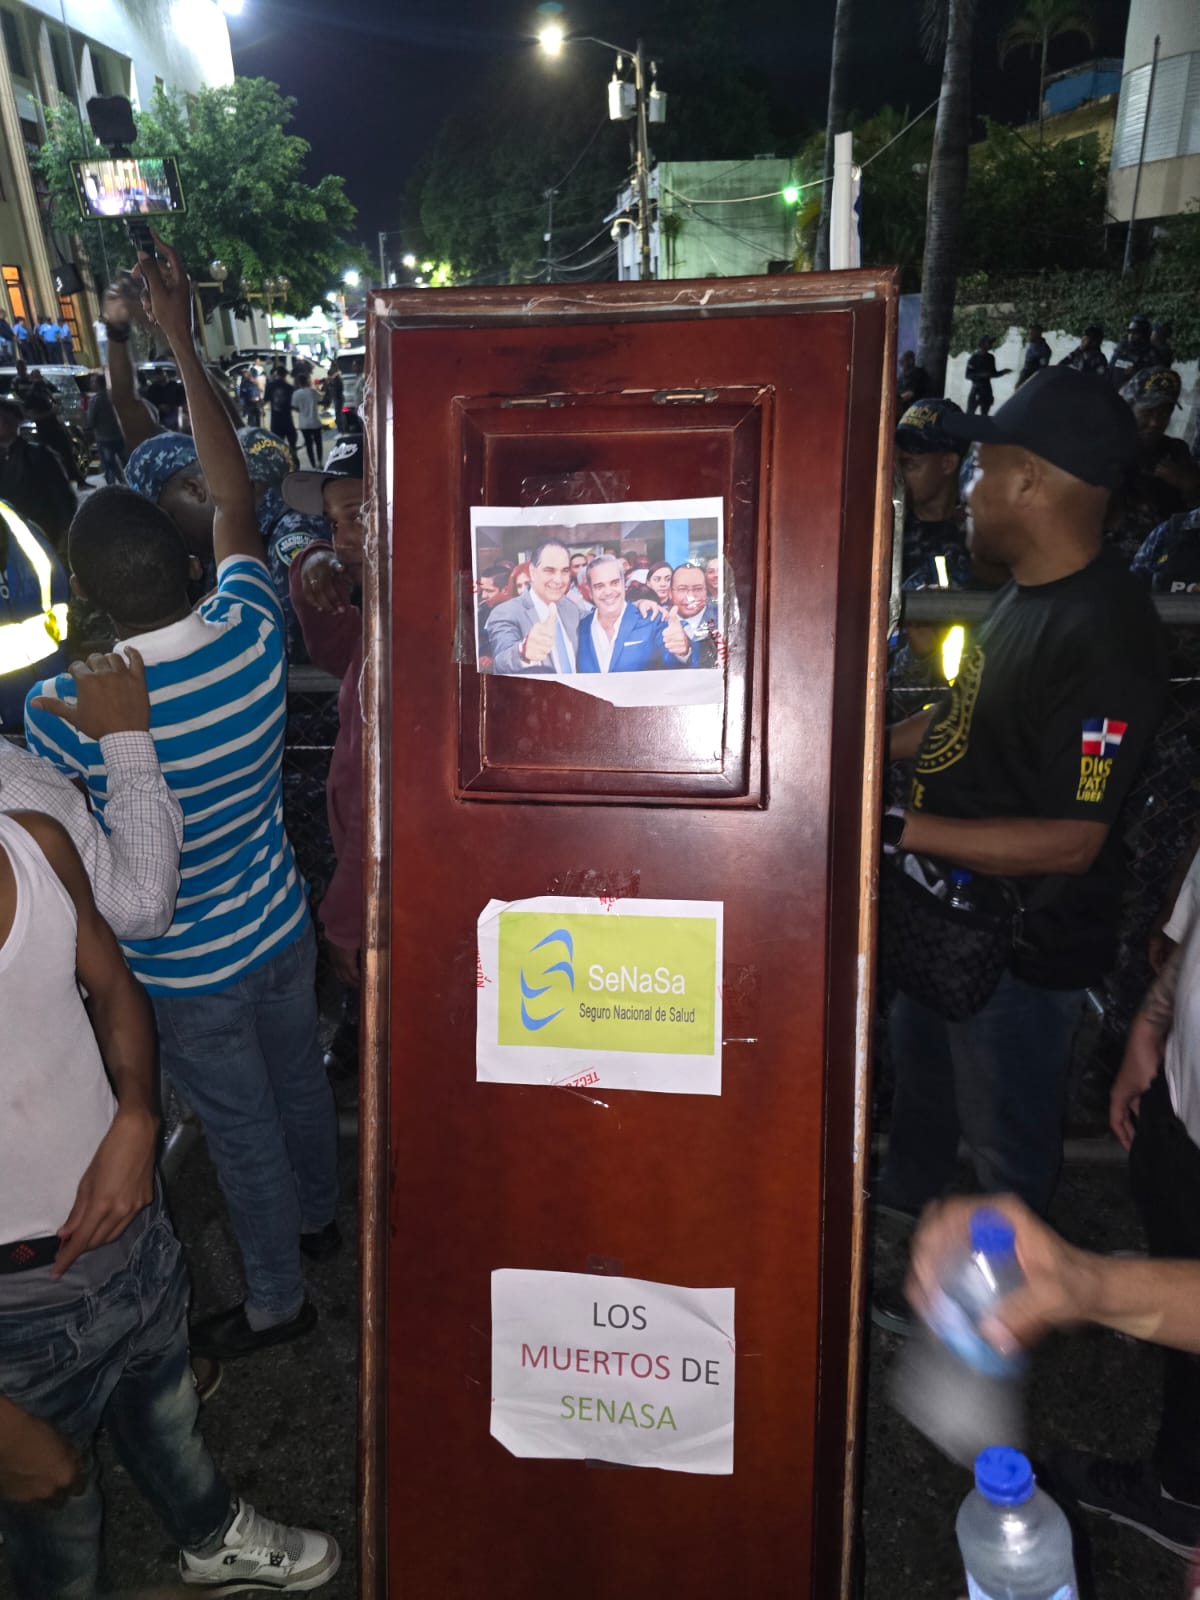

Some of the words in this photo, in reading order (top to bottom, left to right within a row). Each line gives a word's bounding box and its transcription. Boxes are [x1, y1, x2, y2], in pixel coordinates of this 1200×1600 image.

[588, 964, 686, 995] SeNaSa
[579, 1002, 611, 1022] Seguro
[613, 1004, 652, 1021] Nacional
[655, 1007, 666, 1021] de
[669, 1006, 695, 1023] Salud
[593, 1302, 647, 1330] LOS
[521, 1343, 671, 1380] MUERTOS
[682, 1358, 720, 1386] DE
[560, 1395, 677, 1431] SENASA
